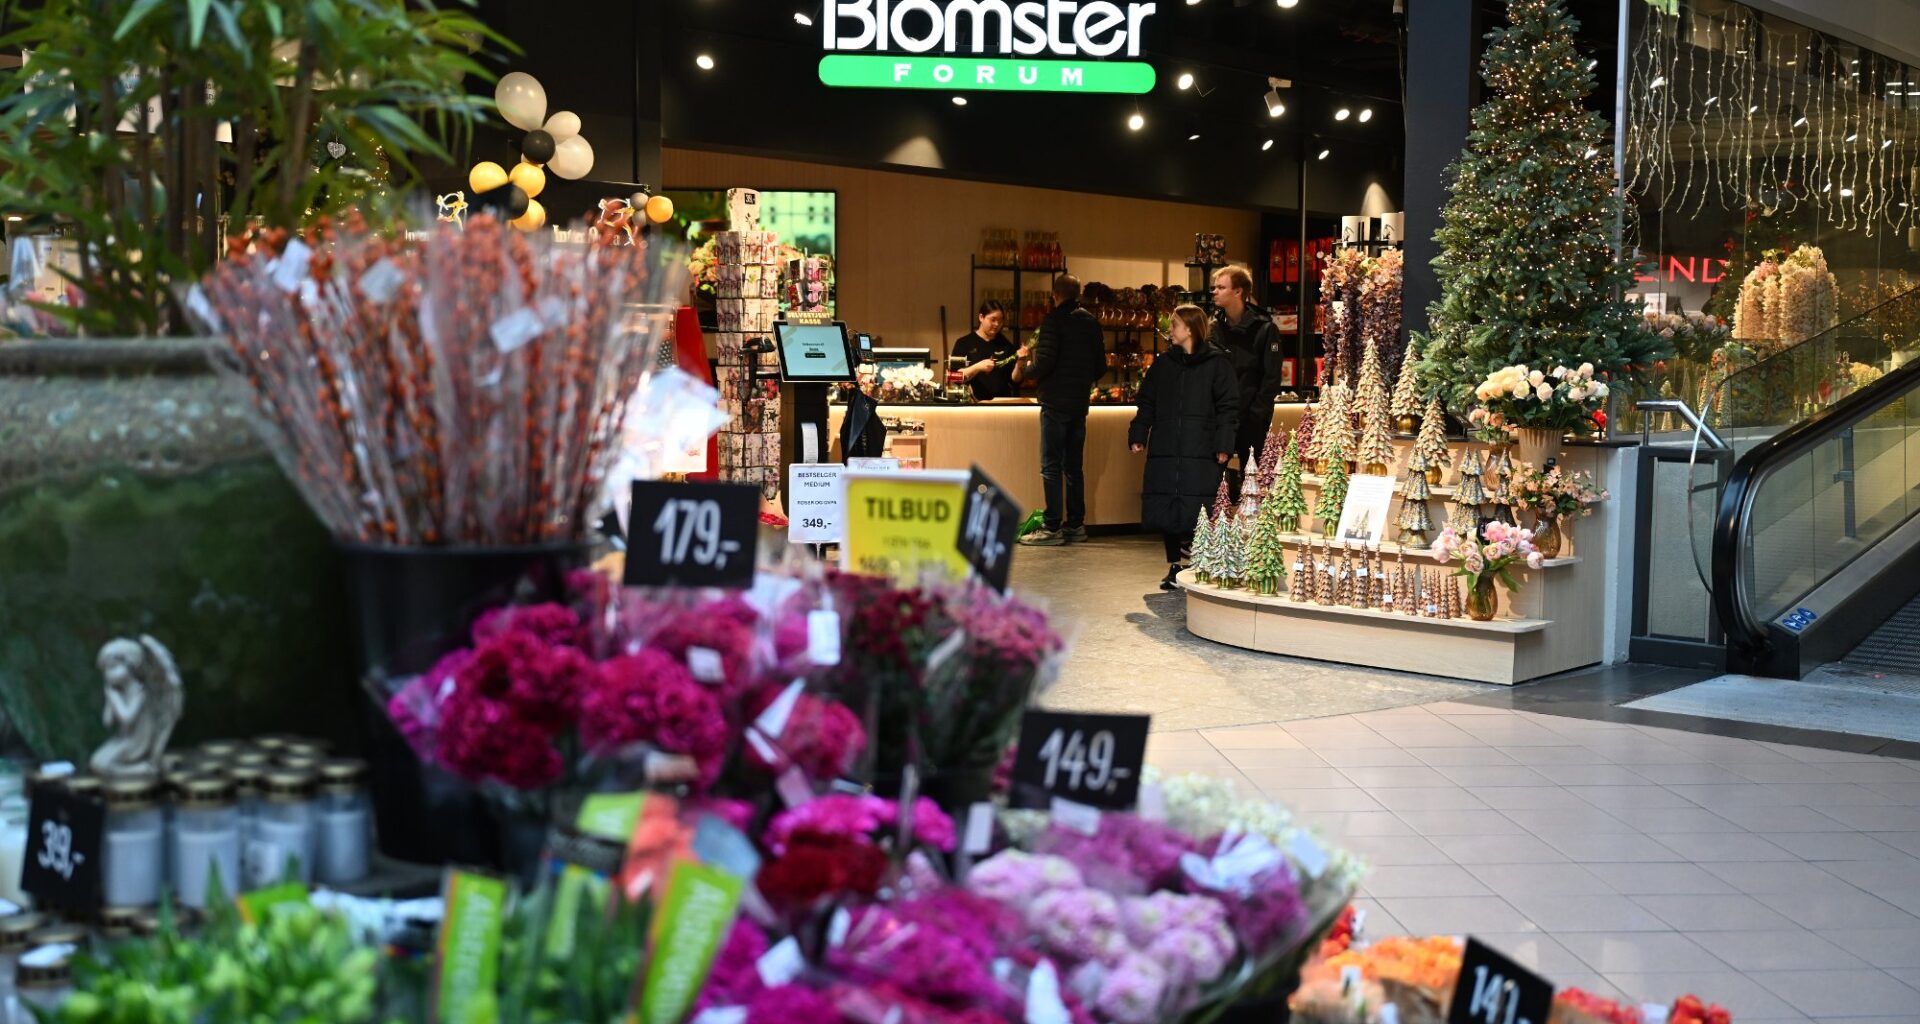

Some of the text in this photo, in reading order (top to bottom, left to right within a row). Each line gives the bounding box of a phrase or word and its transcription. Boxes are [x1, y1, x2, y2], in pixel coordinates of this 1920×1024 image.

[823, 0, 1157, 57] Blomster
[894, 62, 1084, 87] FORUM
[653, 498, 741, 570] 179,-
[802, 518, 832, 529] 349,-
[865, 496, 951, 523] TILBUD
[1038, 727, 1132, 796] 149,-
[37, 820, 86, 882] 39,-
